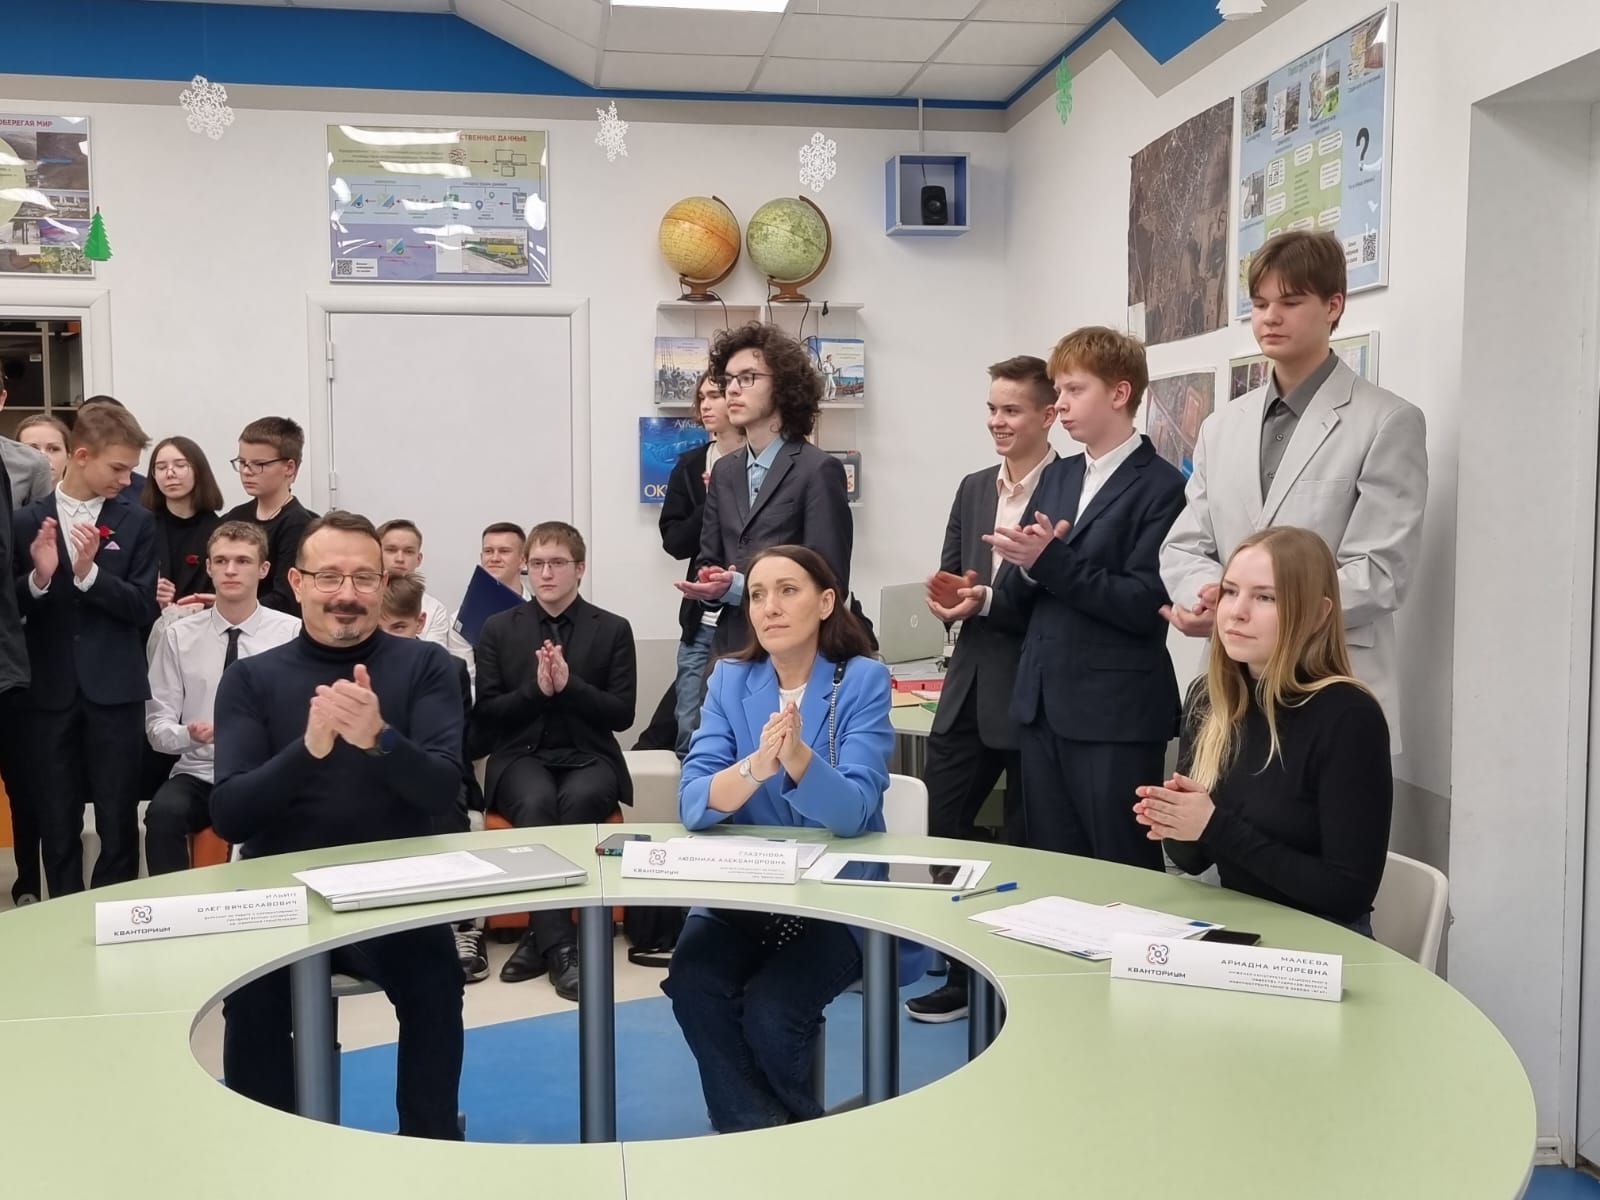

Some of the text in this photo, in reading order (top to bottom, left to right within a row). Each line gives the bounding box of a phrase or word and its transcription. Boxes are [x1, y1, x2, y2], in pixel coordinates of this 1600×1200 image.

[459, 134, 496, 142] СТВЕННЫЕ
[644, 484, 668, 497] ОК
[224, 901, 297, 911] ВЯЧЕСЛАВОВИЧ
[113, 927, 171, 937] КВАНТОРИУМ
[1281, 956, 1329, 967] МАЛЕЕВА
[1128, 967, 1186, 979] КВАНТОРИУМ
[1220, 960, 1328, 977] АРИАДНА ИГОРЕВНА
